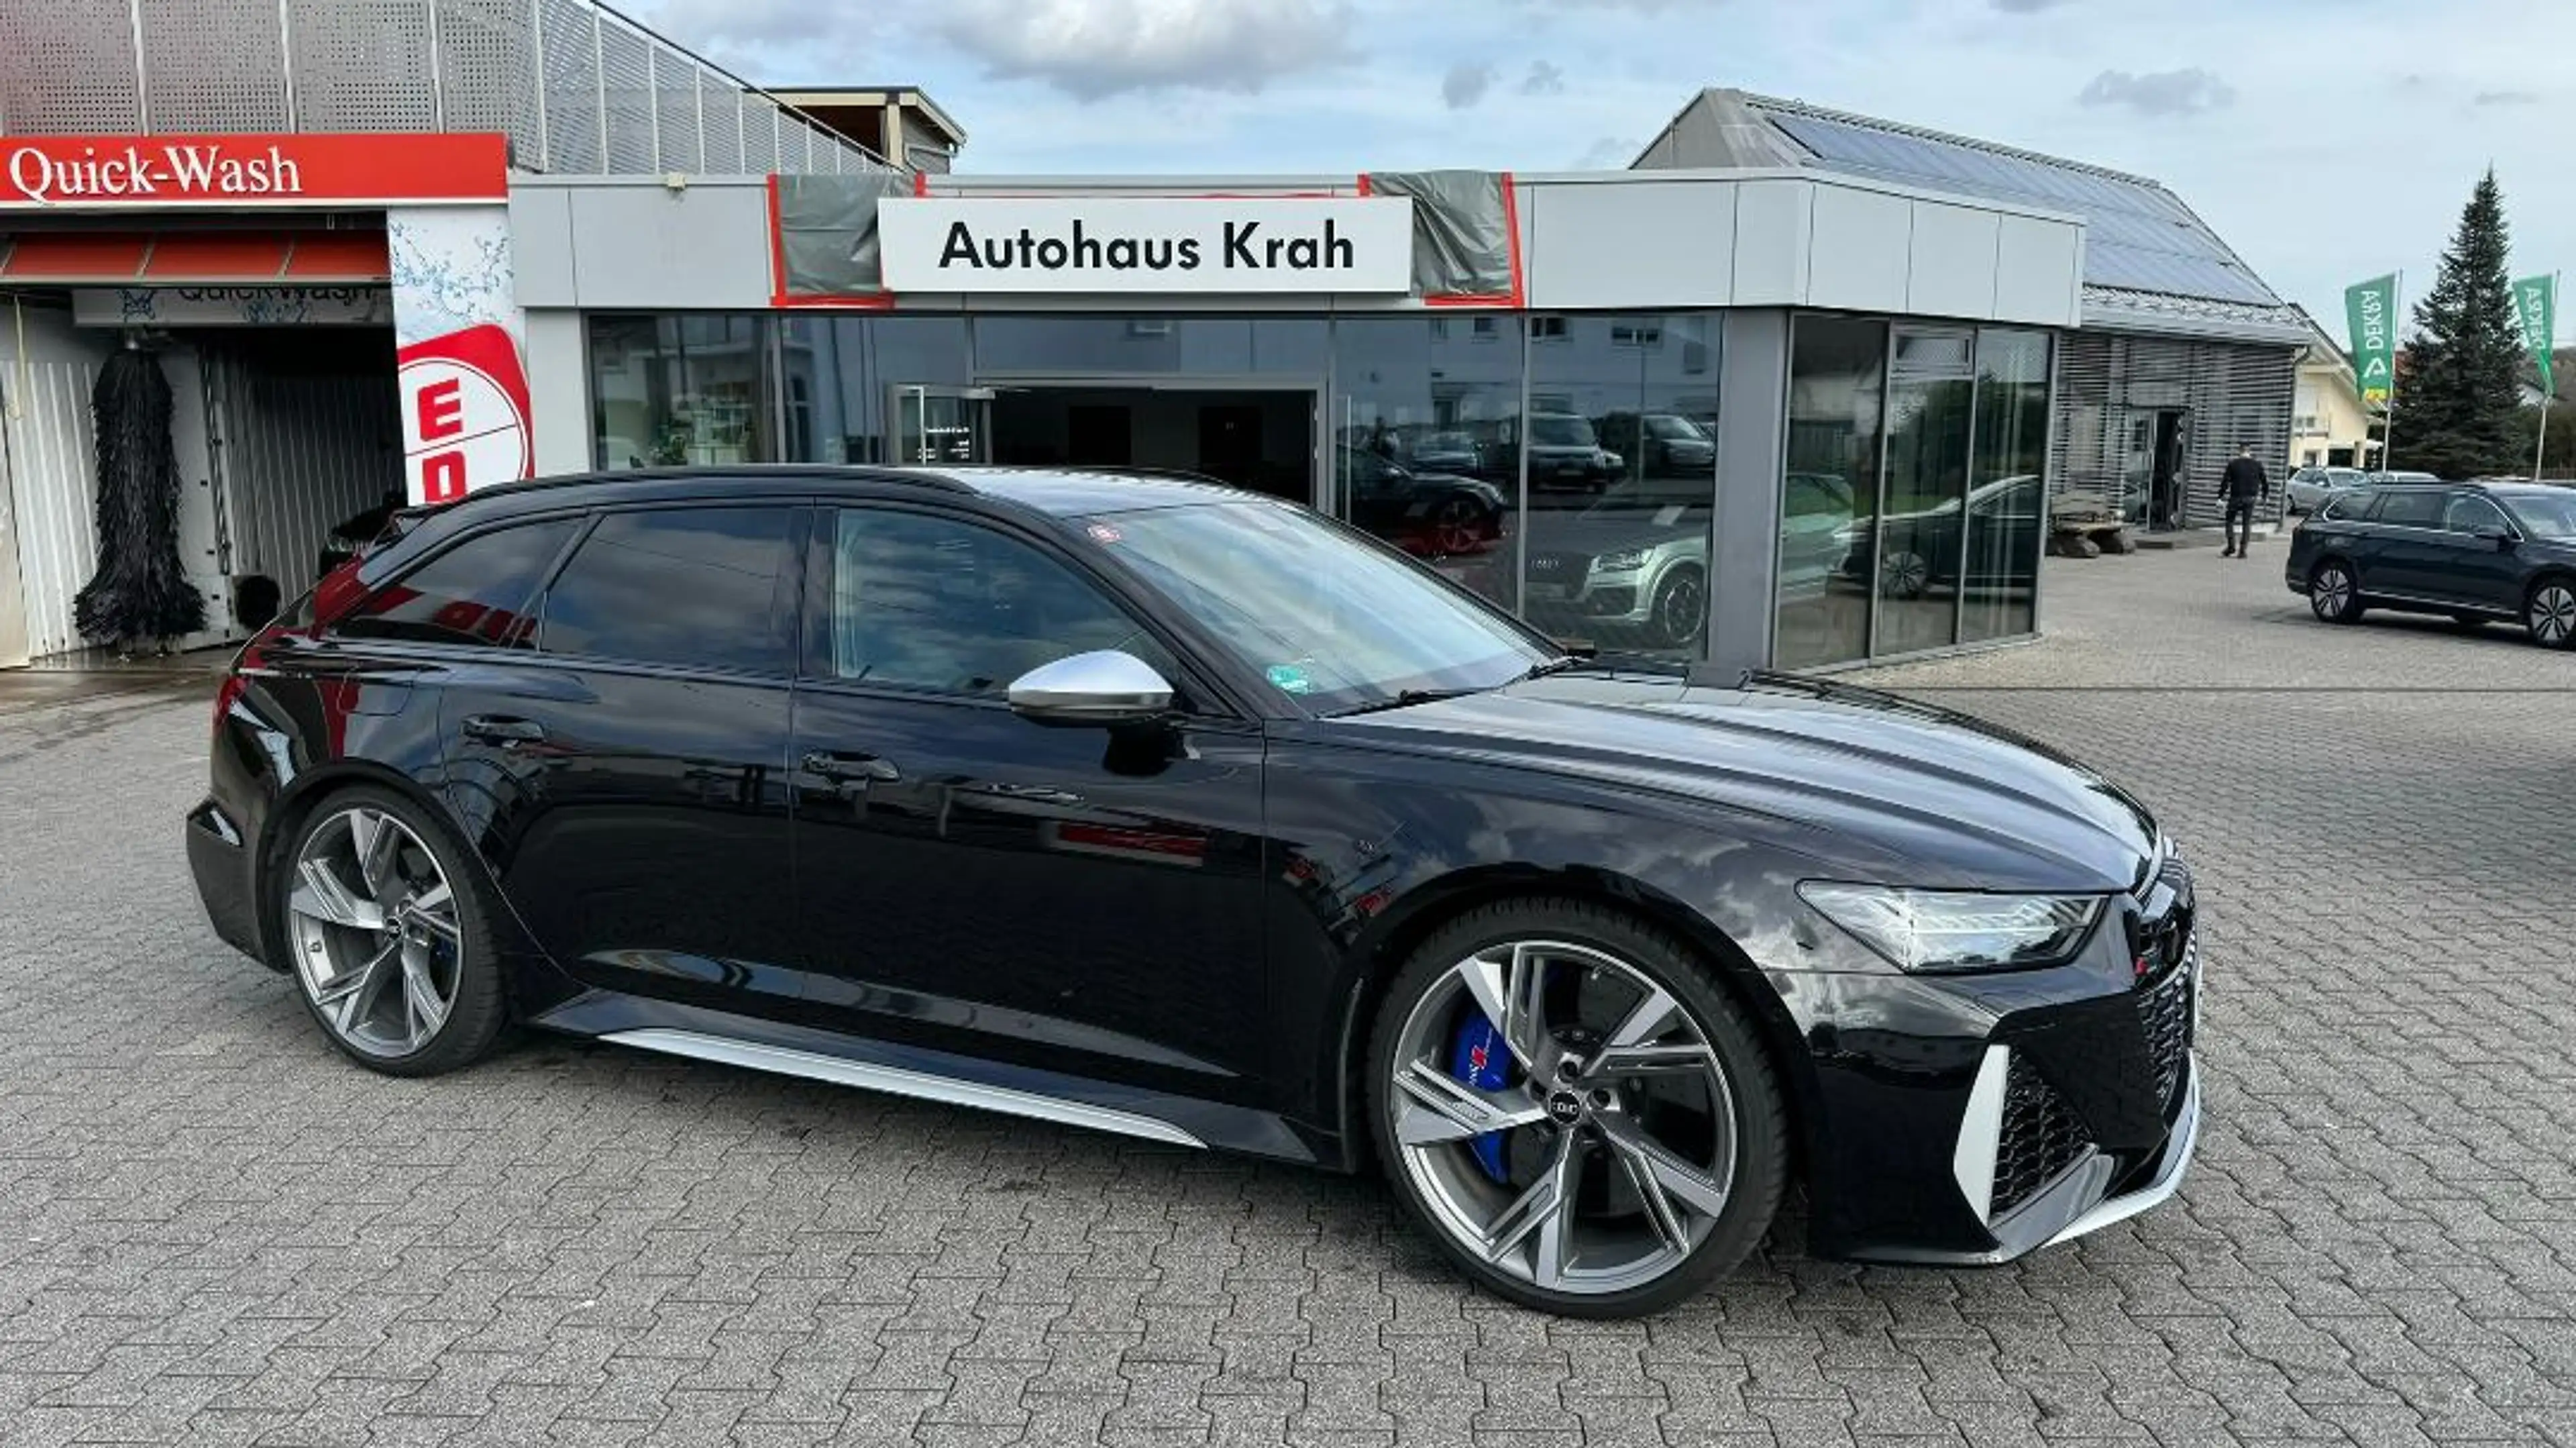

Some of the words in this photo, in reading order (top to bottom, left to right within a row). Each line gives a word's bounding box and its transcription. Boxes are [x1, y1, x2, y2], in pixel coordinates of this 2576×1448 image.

[9, 146, 303, 203] Quick-Wash
[939, 219, 1201, 269] Autohaus
[1224, 219, 1354, 269] Krah
